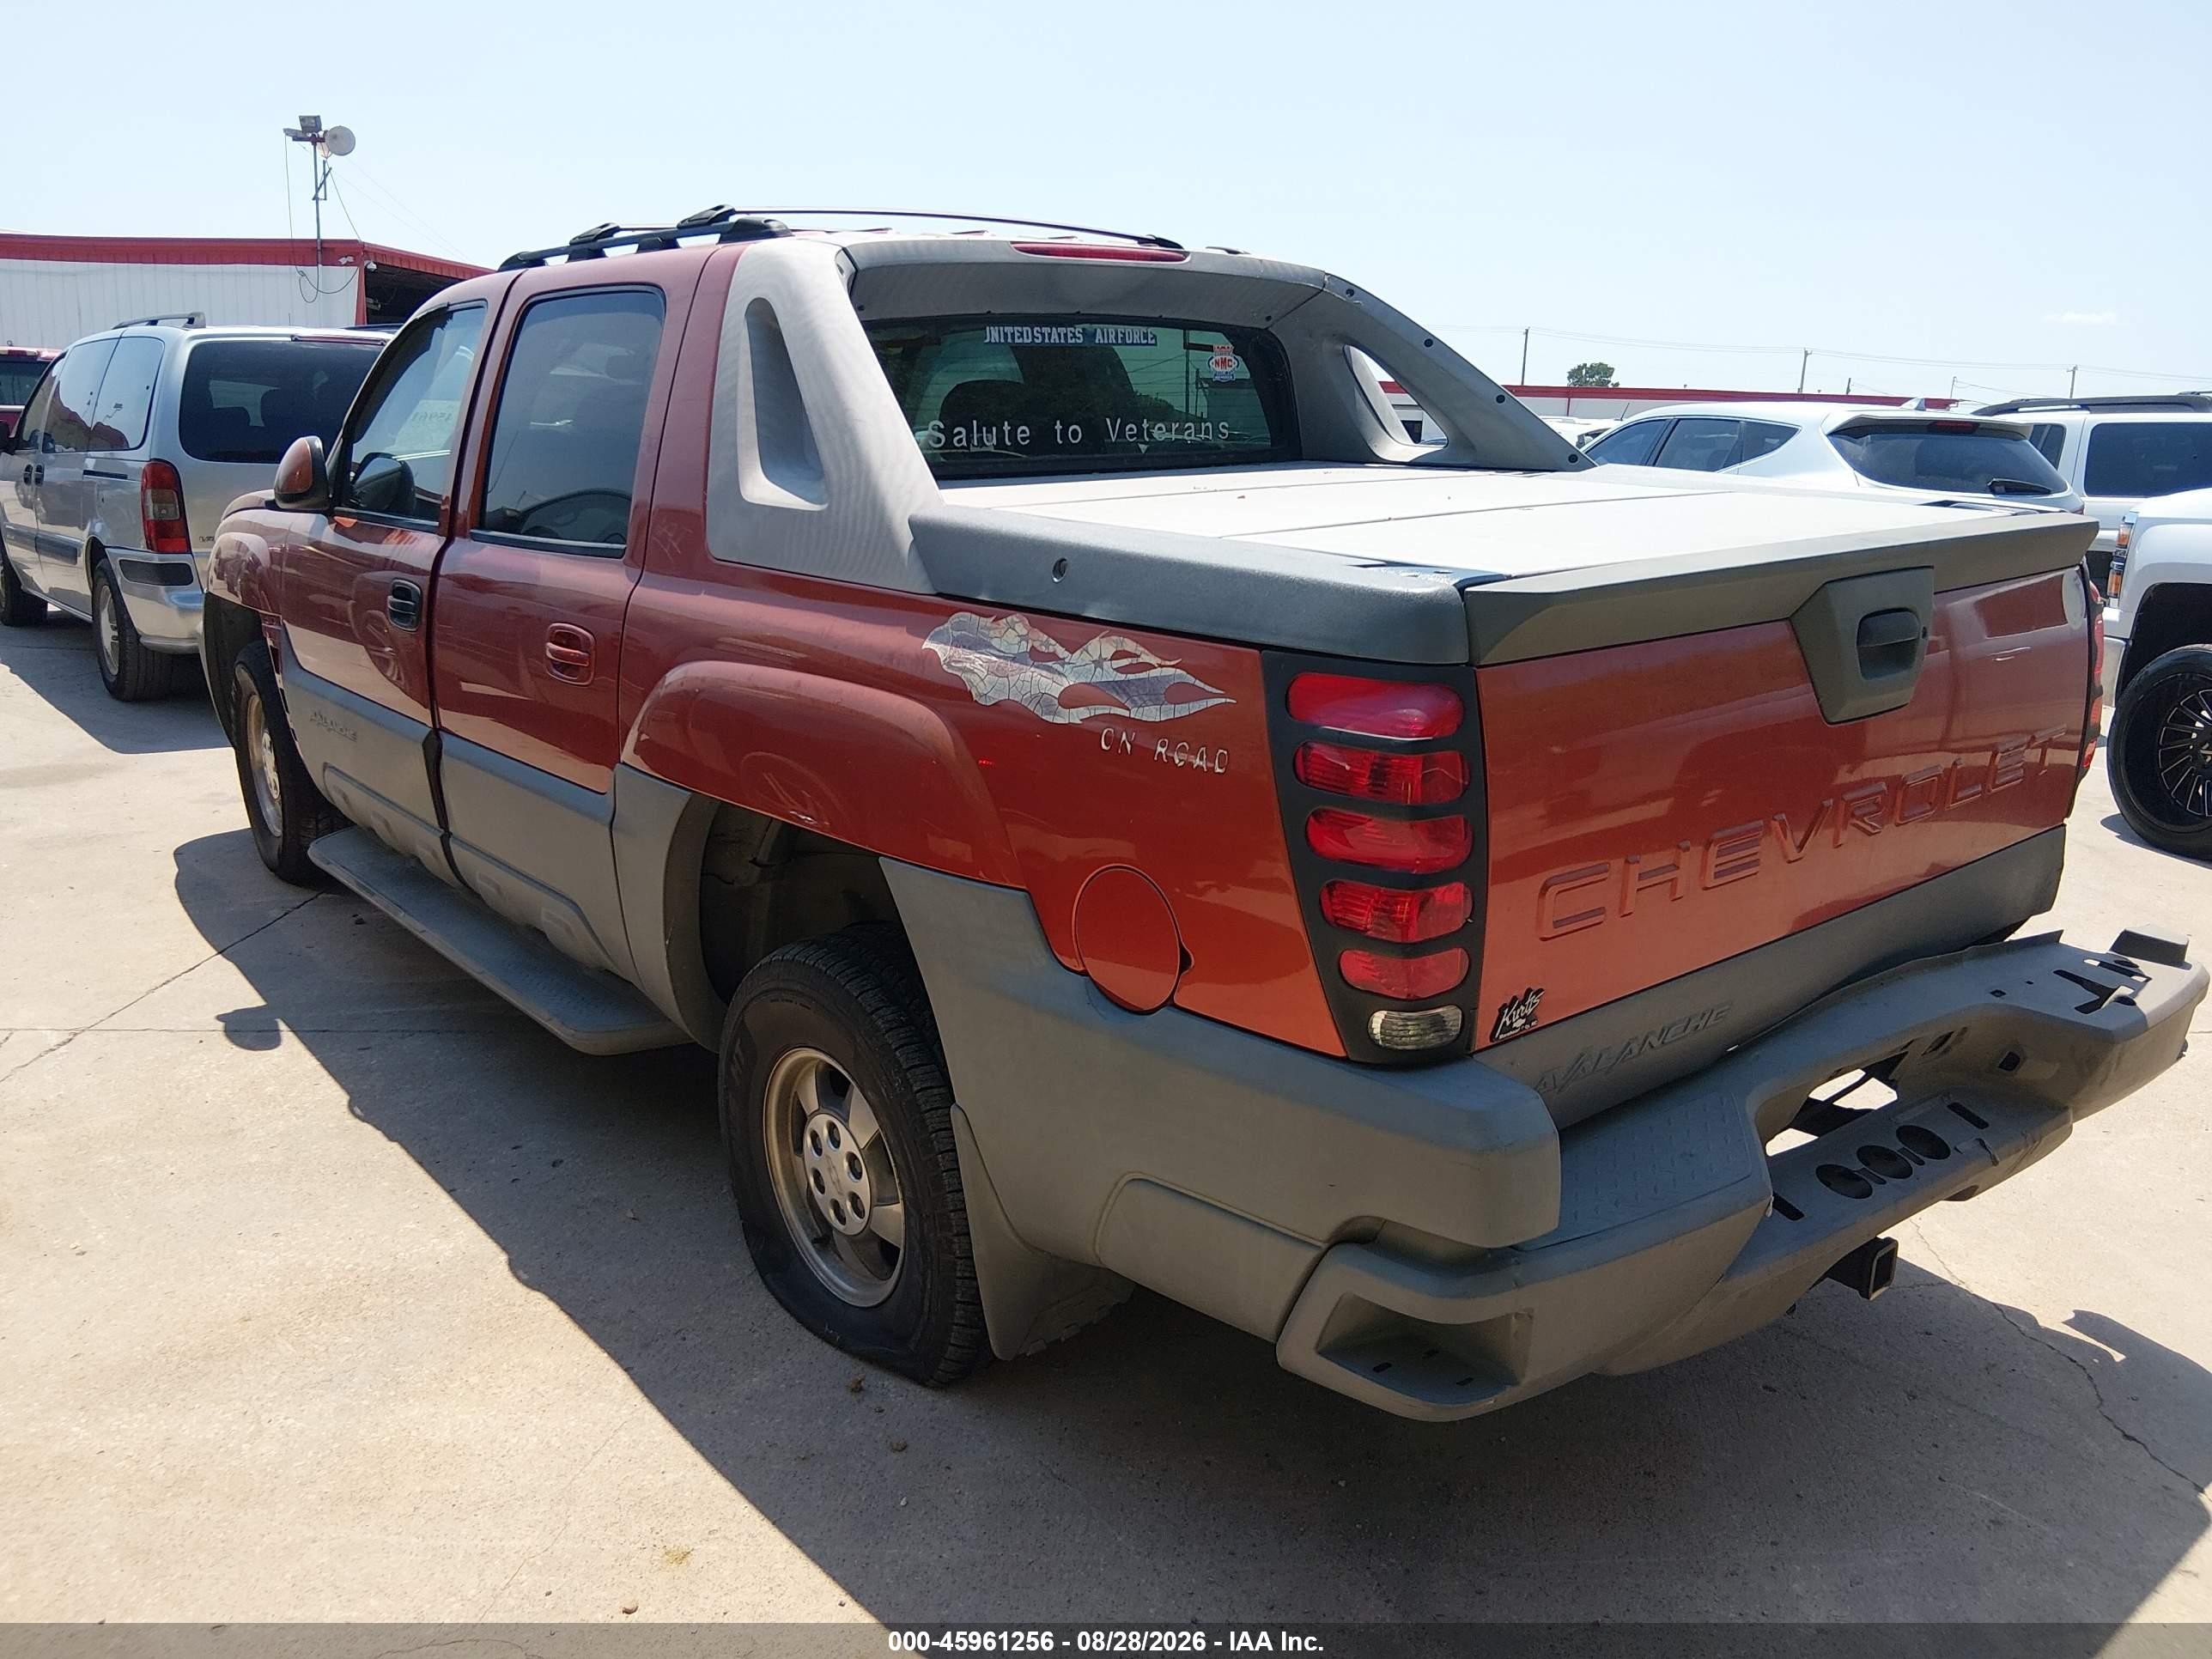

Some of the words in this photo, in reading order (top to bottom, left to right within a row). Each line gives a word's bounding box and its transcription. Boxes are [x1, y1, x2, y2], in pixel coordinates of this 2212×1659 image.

[1033, 326, 1084, 343] STATES
[1214, 356, 1233, 370] NMC
[927, 420, 1030, 448] Salute
[1054, 420, 1083, 444] to
[1106, 418, 1230, 444] Veterans
[1100, 726, 1136, 757] ON
[1153, 737, 1231, 775] ROAD
[1535, 724, 2066, 942] CHEVROLET
[1532, 1002, 1732, 1093] AVALANCHE
